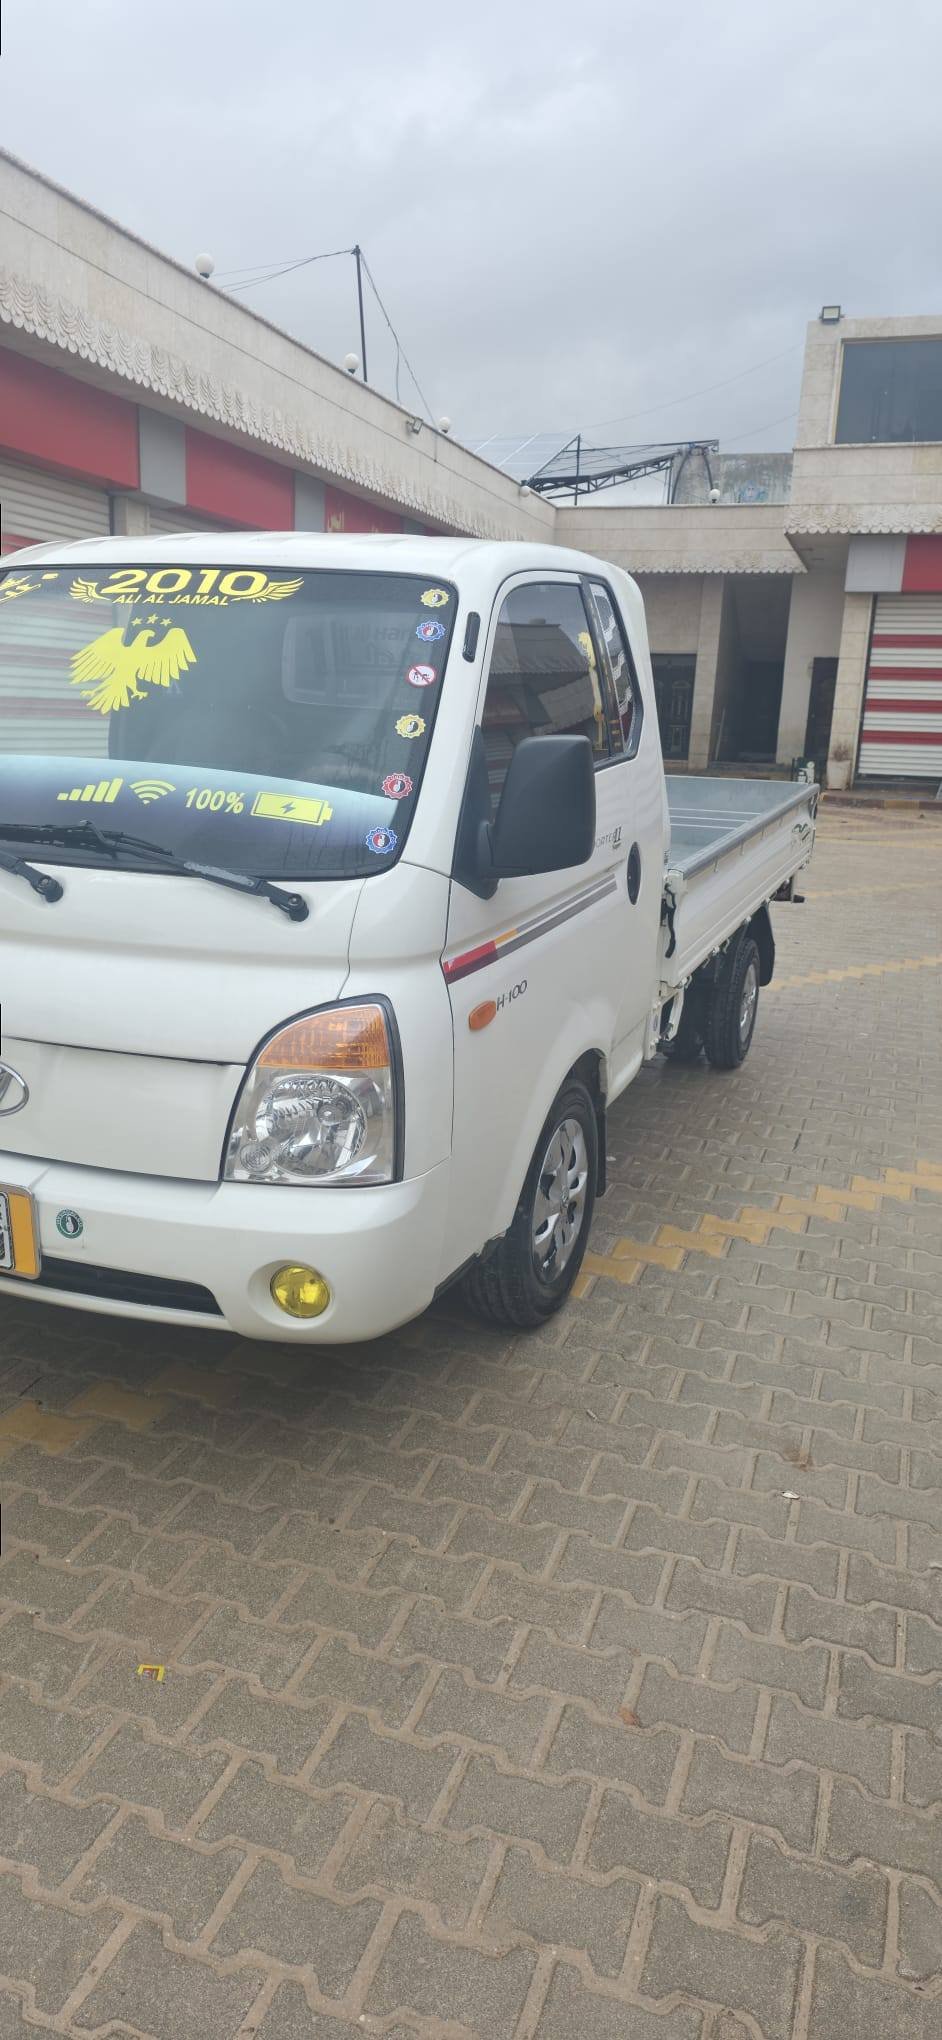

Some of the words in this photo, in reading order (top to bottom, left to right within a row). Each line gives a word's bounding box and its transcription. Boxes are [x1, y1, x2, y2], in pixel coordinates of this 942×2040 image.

[101, 569, 267, 595] 2010
[113, 595, 142, 603] ALI
[143, 595, 164, 603] AL
[168, 595, 229, 605] JAMAL
[185, 788, 245, 814] 100%
[496, 979, 527, 1011] H-100
